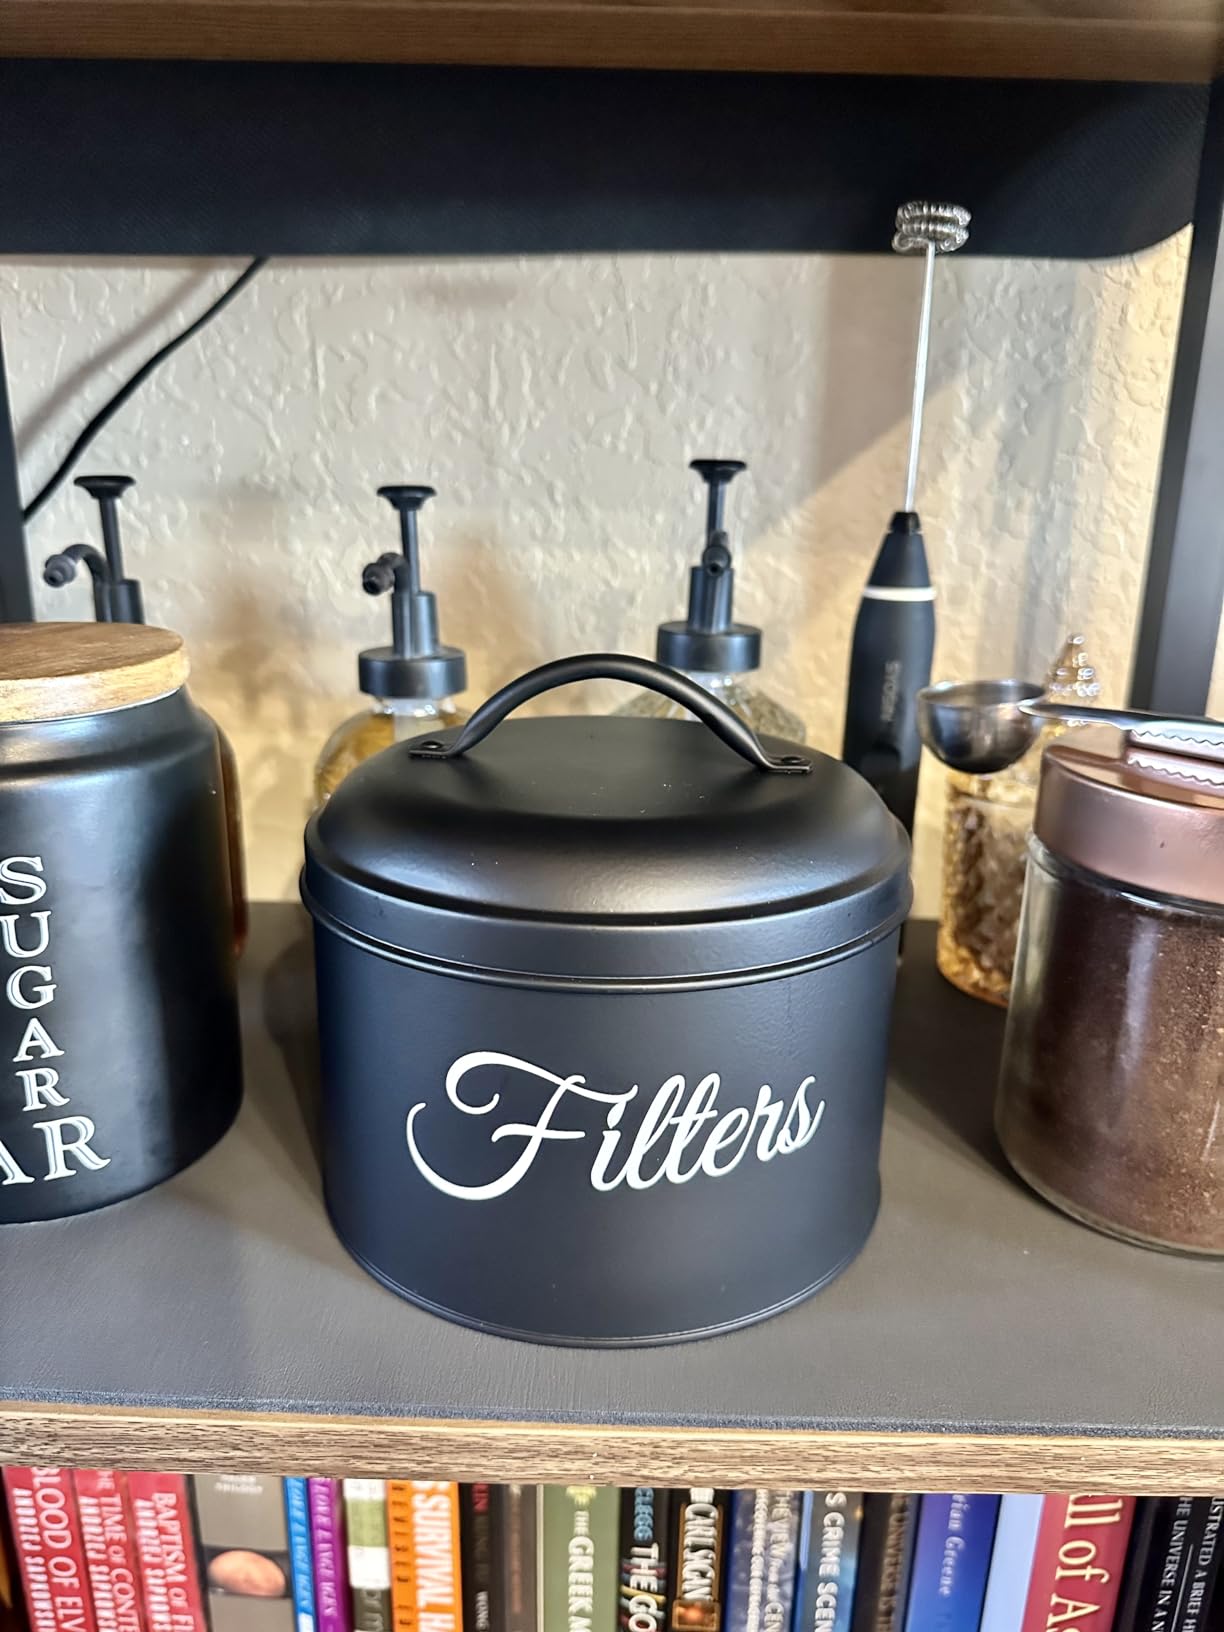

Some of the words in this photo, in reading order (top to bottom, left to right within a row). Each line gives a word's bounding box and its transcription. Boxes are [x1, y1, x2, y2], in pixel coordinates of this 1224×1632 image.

[406, 1051, 826, 1201] Filters
[96, 1470, 116, 1490] HE
[32, 1467, 72, 1549] BLOOD
[99, 1494, 128, 1542] TIME
[947, 1494, 970, 1531] rian
[152, 1493, 187, 1582] BAPTISM
[412, 1494, 454, 1609] SURVIVAL
[819, 1512, 845, 1576] CRIME
[1055, 1540, 1110, 1583] of
[1159, 1520, 1188, 1587] UNIVERSE
[47, 1556, 80, 1590] OF
[568, 1536, 594, 1614] GREEK
[629, 1542, 659, 1592] THE
[938, 1536, 965, 1596] Greene
[1194, 1570, 1208, 1578] A
[55, 1596, 88, 1632] ELV
[1153, 1607, 1166, 1618] A
[1156, 1590, 1173, 1605] IN
[1187, 1582, 1206, 1615] BRIEF
